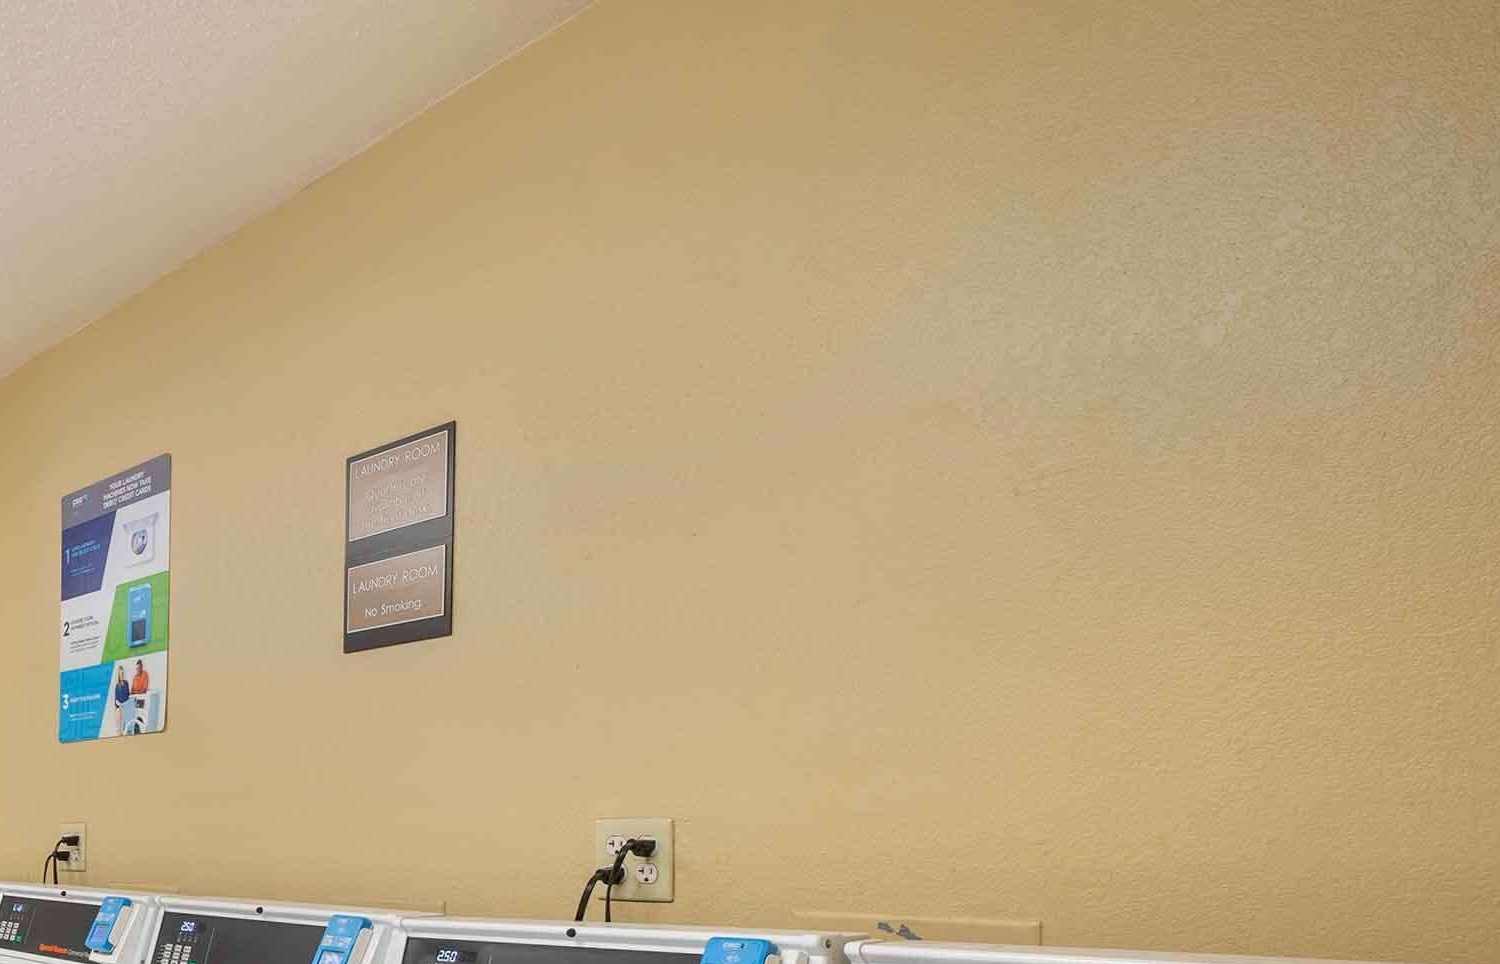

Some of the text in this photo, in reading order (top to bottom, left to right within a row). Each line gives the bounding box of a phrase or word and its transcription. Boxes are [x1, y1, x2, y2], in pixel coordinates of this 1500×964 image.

[355, 441, 441, 480] LAUNDRY ROOM
[352, 566, 438, 594] LAUNDRY ROOM
[380, 599, 421, 616] Smoking
[63, 621, 70, 637] 2
[62, 693, 69, 710] 3
